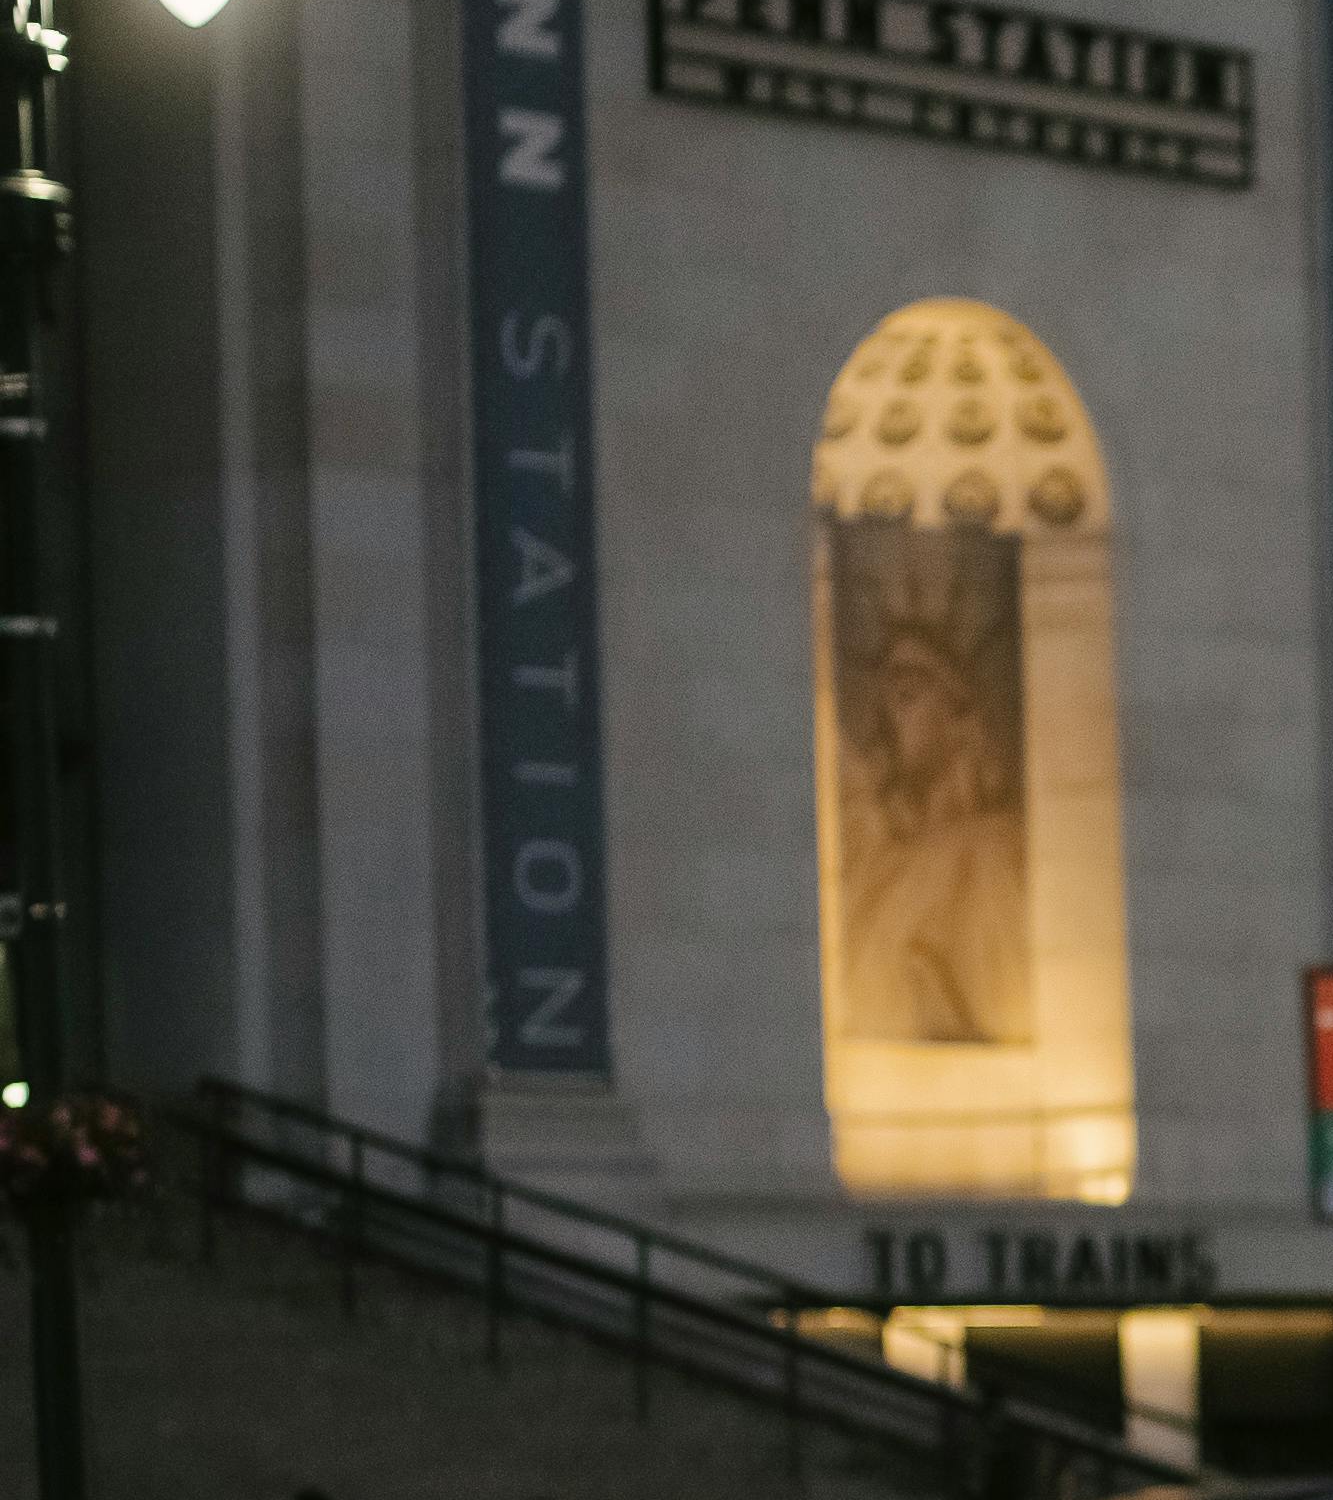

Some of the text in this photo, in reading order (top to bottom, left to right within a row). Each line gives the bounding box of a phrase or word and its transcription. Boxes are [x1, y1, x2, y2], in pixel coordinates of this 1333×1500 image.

[496, 312, 588, 1054] STATION
[866, 1226, 1220, 1300] TO TRAINS
